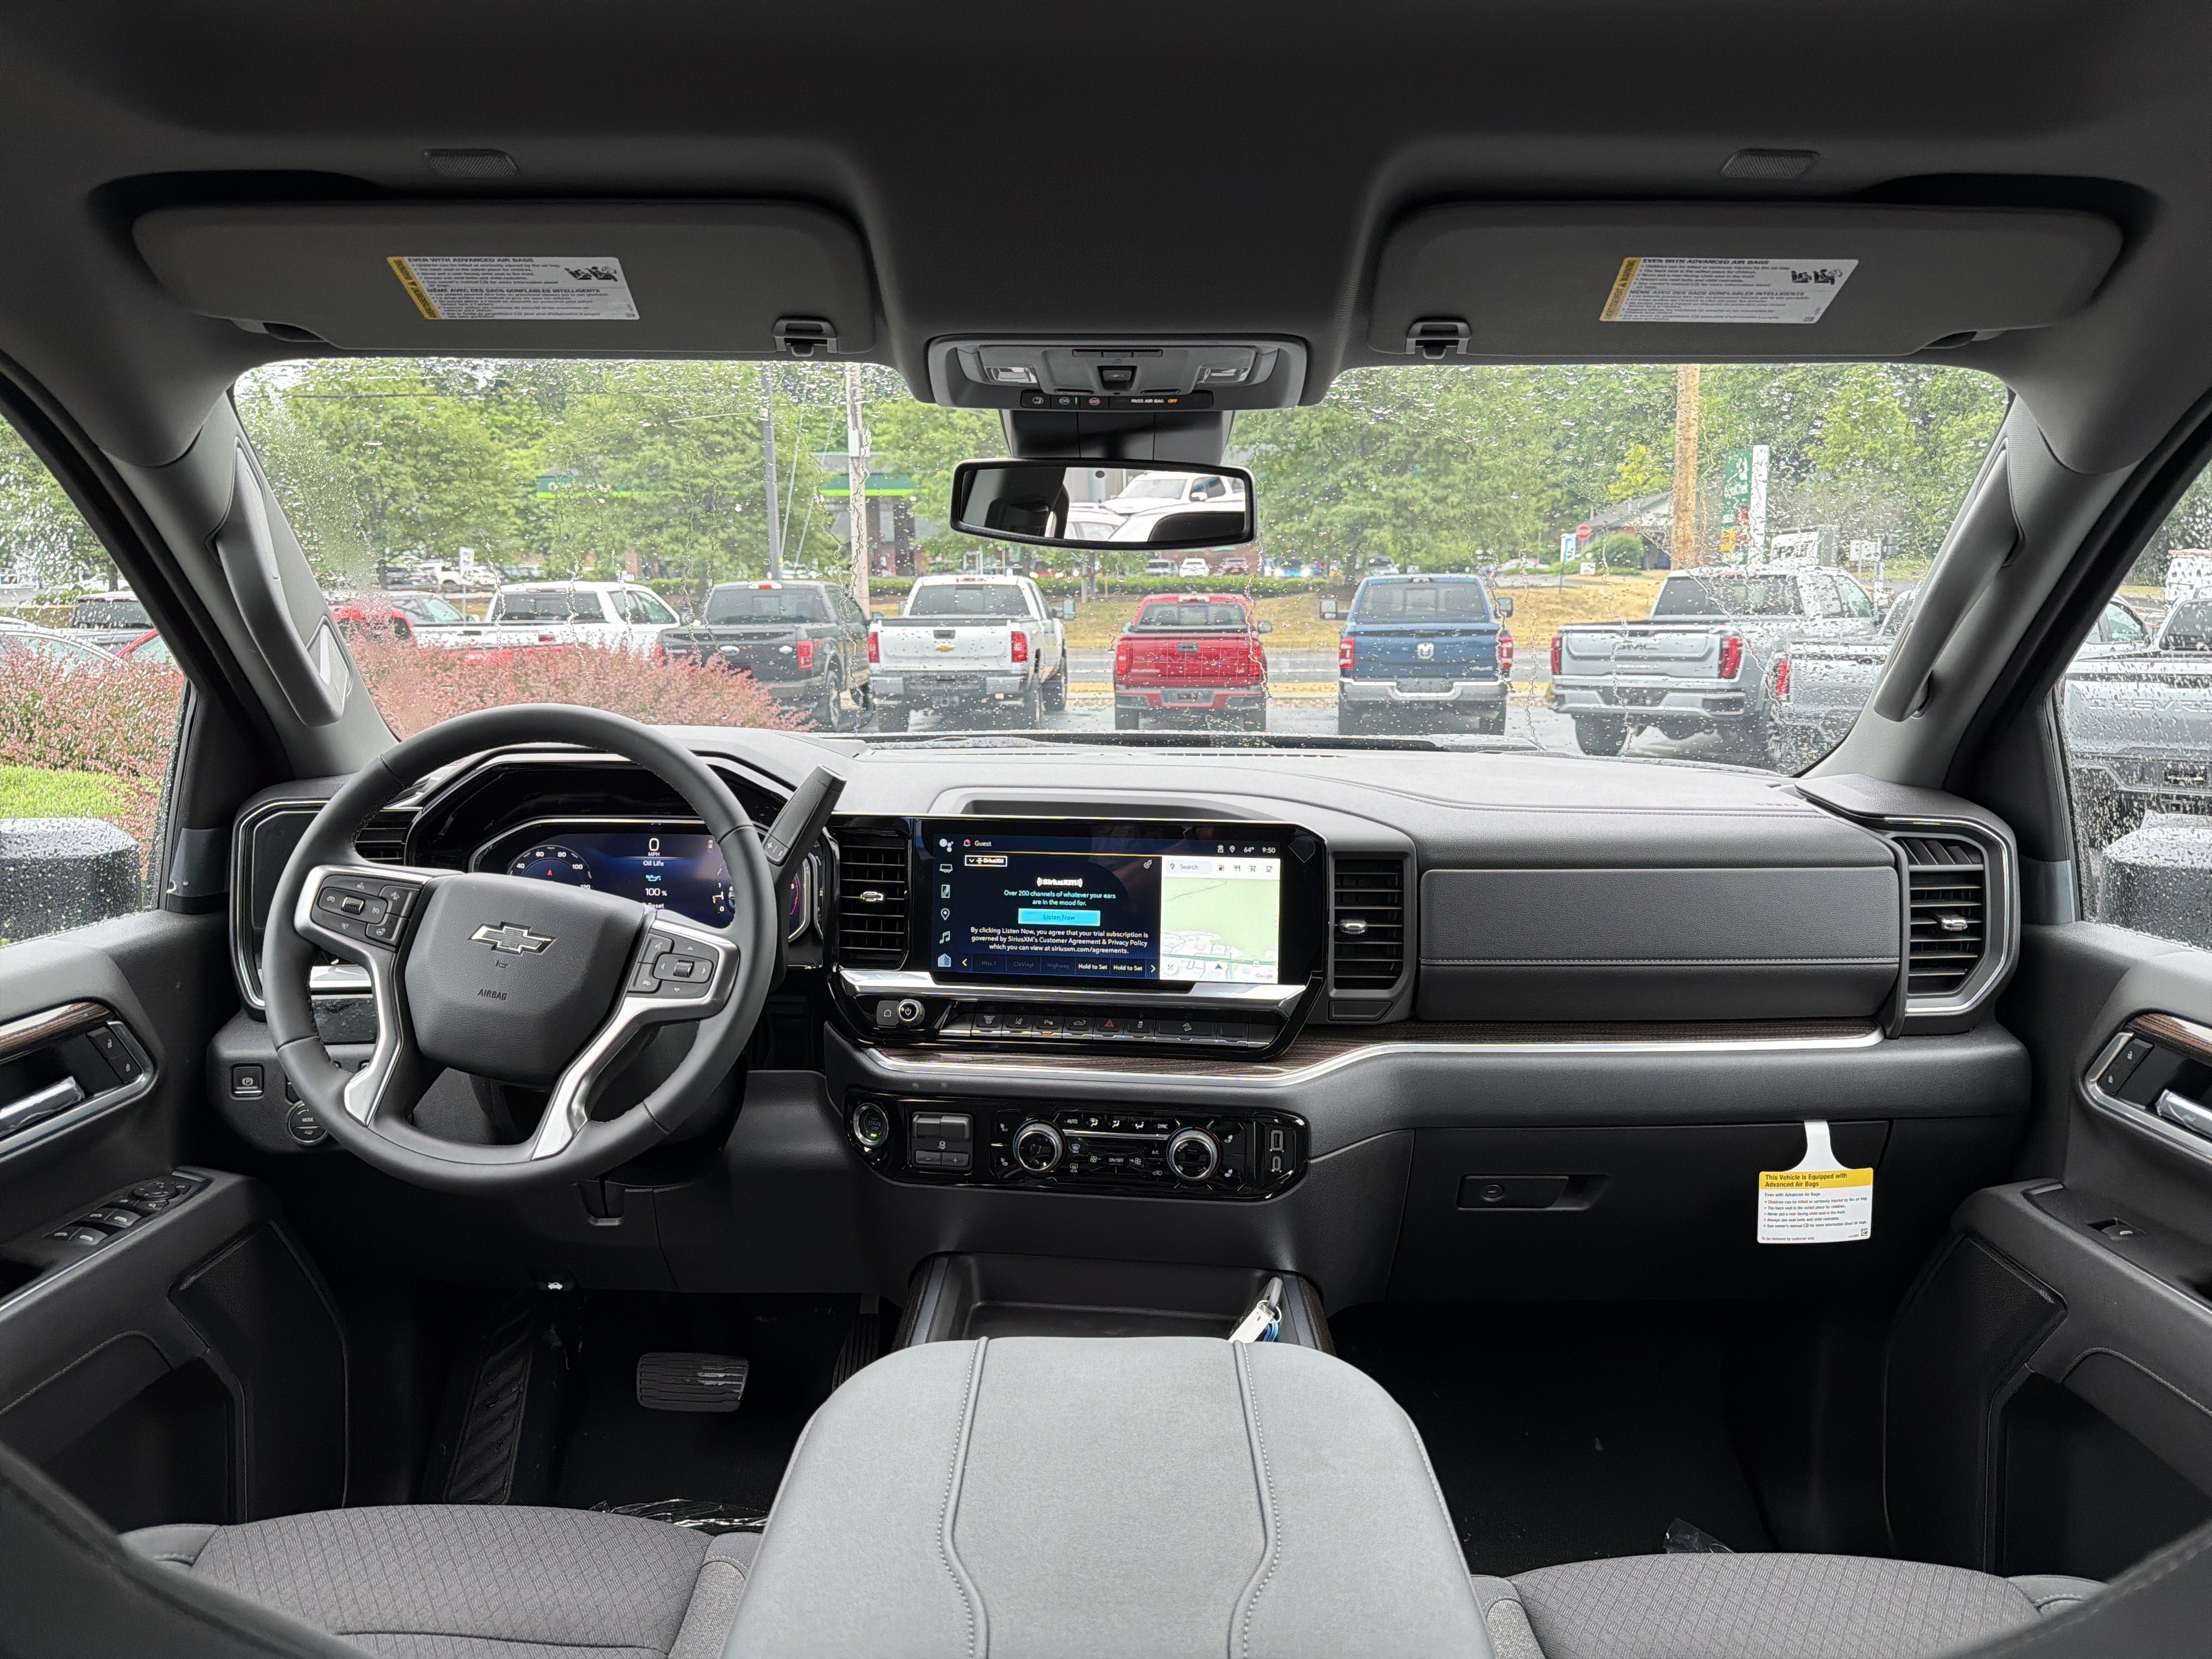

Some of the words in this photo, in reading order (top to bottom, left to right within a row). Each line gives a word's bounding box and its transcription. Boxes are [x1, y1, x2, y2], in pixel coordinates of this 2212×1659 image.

[648, 838, 659, 851] 0
[645, 888, 661, 896] 100
[1051, 946, 1129, 954] siriusxm.com/agreements.
[478, 989, 507, 1001] AIRBAG
